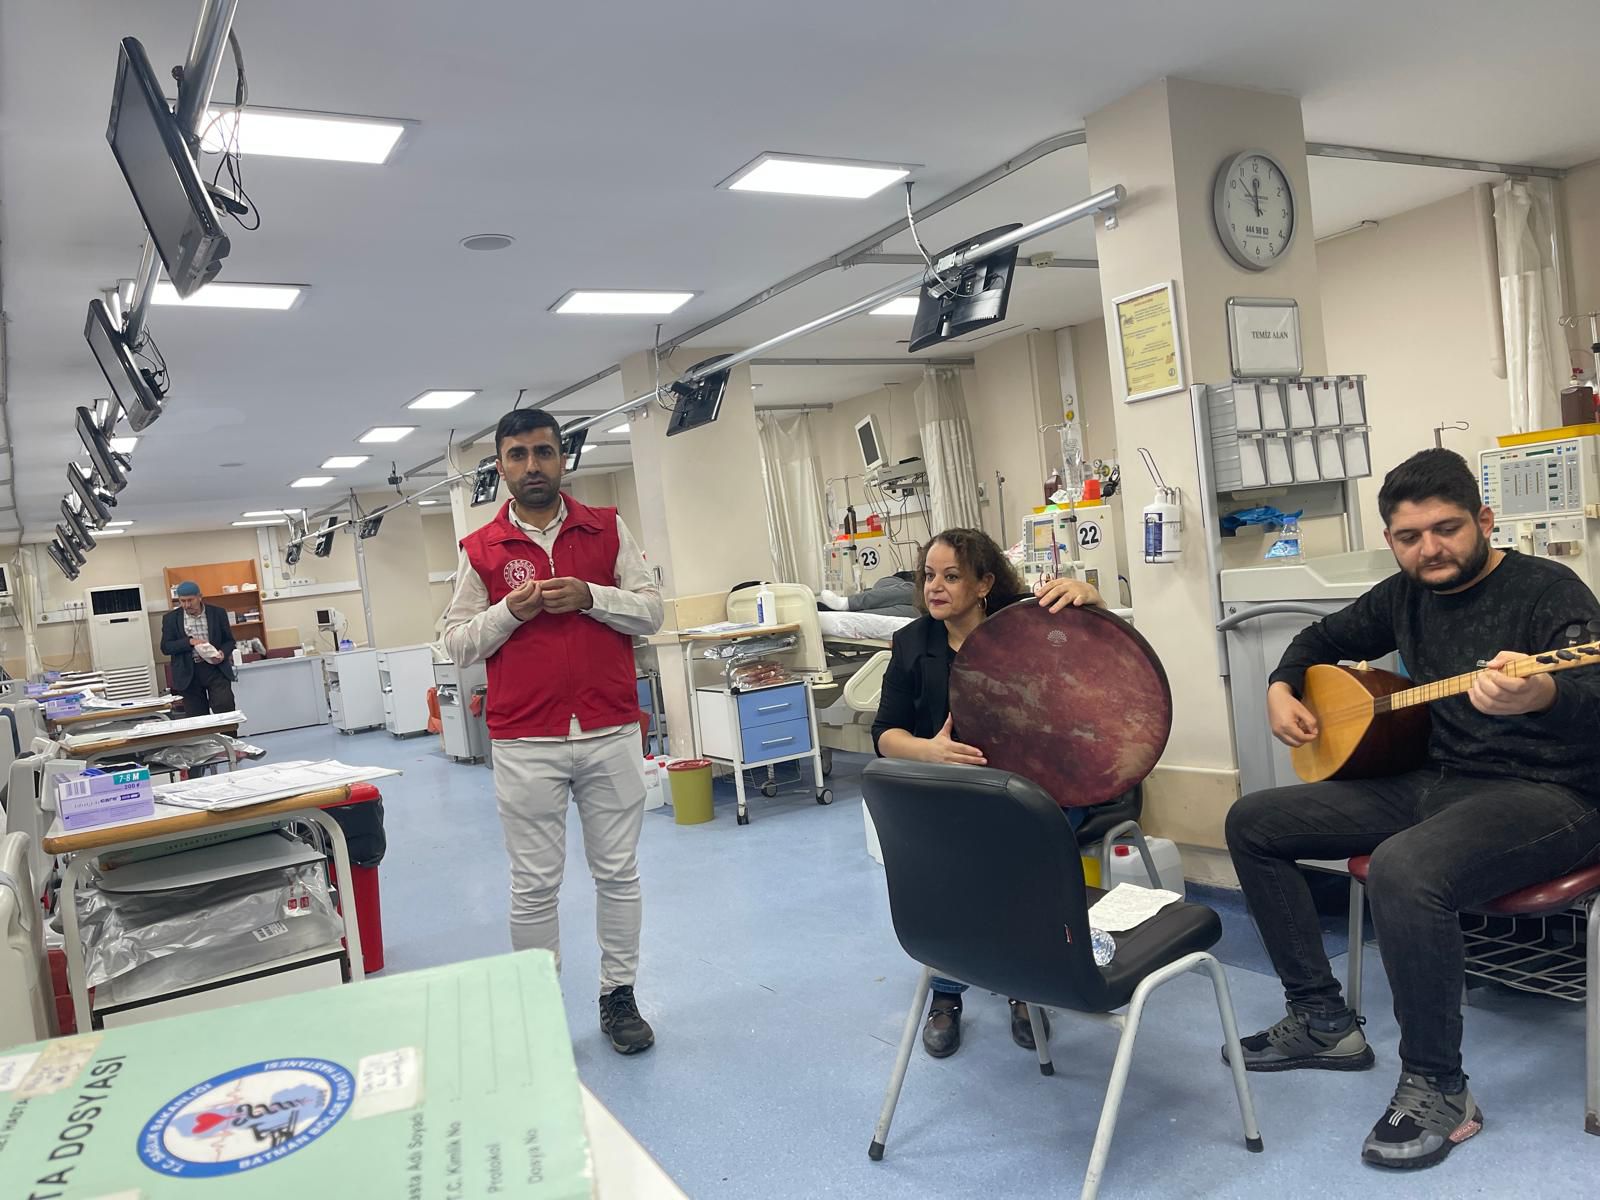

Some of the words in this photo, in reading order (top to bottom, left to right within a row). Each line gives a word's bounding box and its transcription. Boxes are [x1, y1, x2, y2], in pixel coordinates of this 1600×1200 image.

[1252, 163, 1259, 173] 12
[1256, 246, 1261, 256] 6
[1269, 242, 1274, 252] 5
[1251, 329, 1271, 339] TEMİZ
[1272, 330, 1289, 339] ALAN
[1079, 525, 1099, 546] 22
[861, 550, 878, 566] 23
[119, 774, 131, 783] 7-8
[132, 772, 140, 781] M
[48, 1055, 127, 1161] DOSYASI
[446, 1121, 462, 1138] No
[522, 1127, 539, 1145] No
[238, 1134, 311, 1169] BATMAN
[485, 1142, 505, 1194] Protokol
[526, 1146, 546, 1185] Dosya
